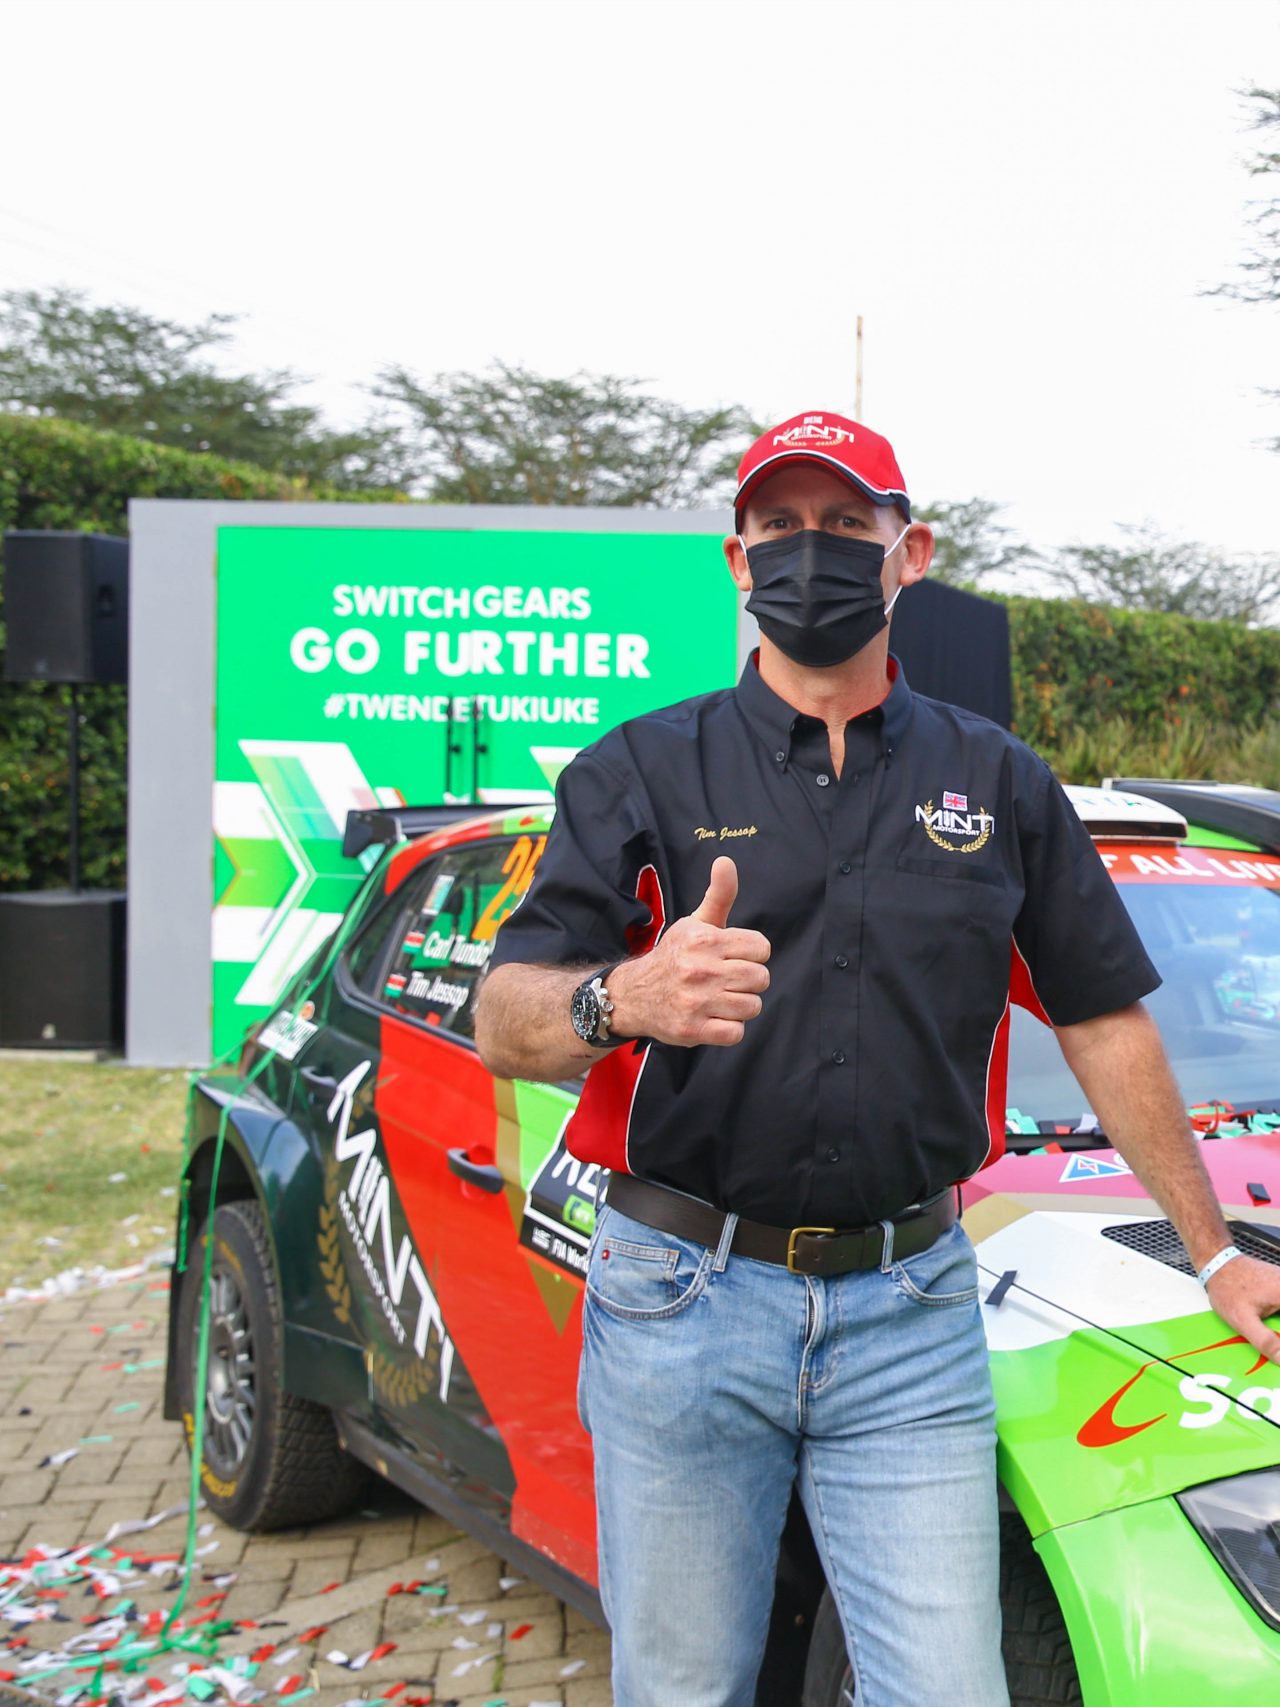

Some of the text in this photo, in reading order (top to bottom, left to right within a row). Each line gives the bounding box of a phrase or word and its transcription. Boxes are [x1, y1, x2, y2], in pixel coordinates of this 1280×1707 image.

[772, 425, 855, 447] MINTI
[290, 626, 652, 679] GO FURTHER
[694, 825, 758, 841] Tim Jessop
[932, 824, 981, 837] MOTORSPORT
[1130, 854, 1214, 877] ALL
[422, 931, 456, 961] Carl
[405, 970, 469, 1012] Tim Jessop
[327, 1060, 456, 1404] MINTI
[338, 1189, 407, 1345] MOTORSPORT
